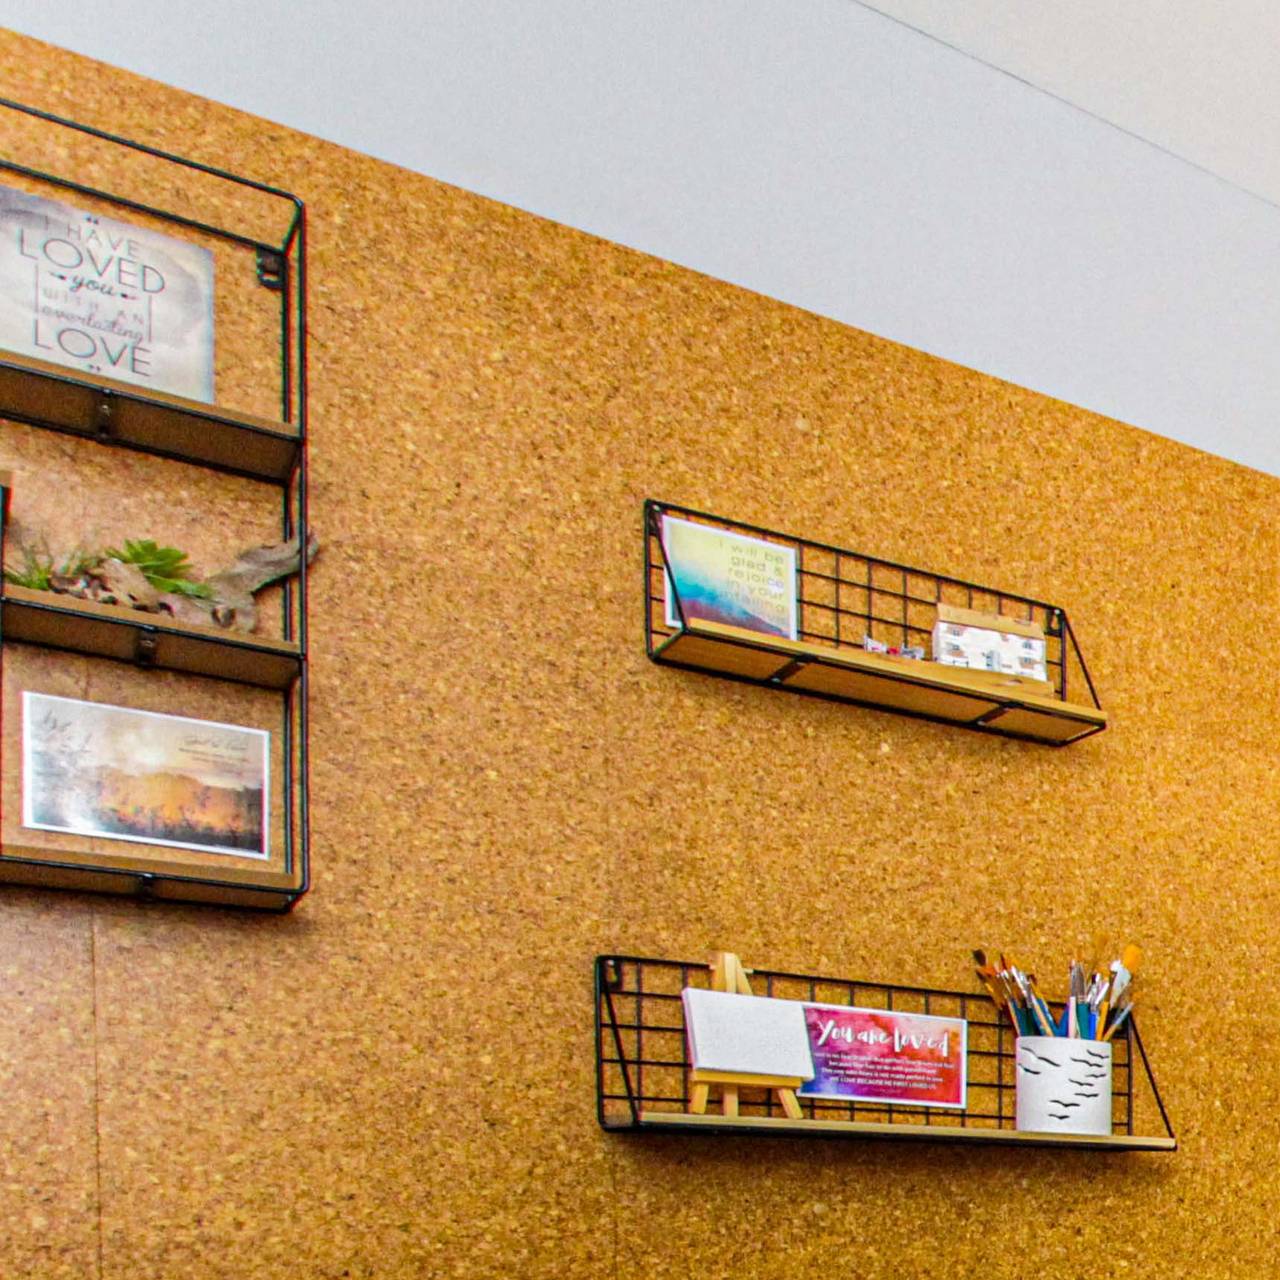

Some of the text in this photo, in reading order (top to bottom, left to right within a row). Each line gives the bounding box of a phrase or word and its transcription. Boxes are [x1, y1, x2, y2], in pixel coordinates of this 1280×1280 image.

[66, 222, 142, 258] HAVE
[18, 227, 165, 294] LOVED
[69, 274, 115, 297] you
[33, 318, 152, 378] LOVE
[816, 1019, 948, 1057] You are loved
